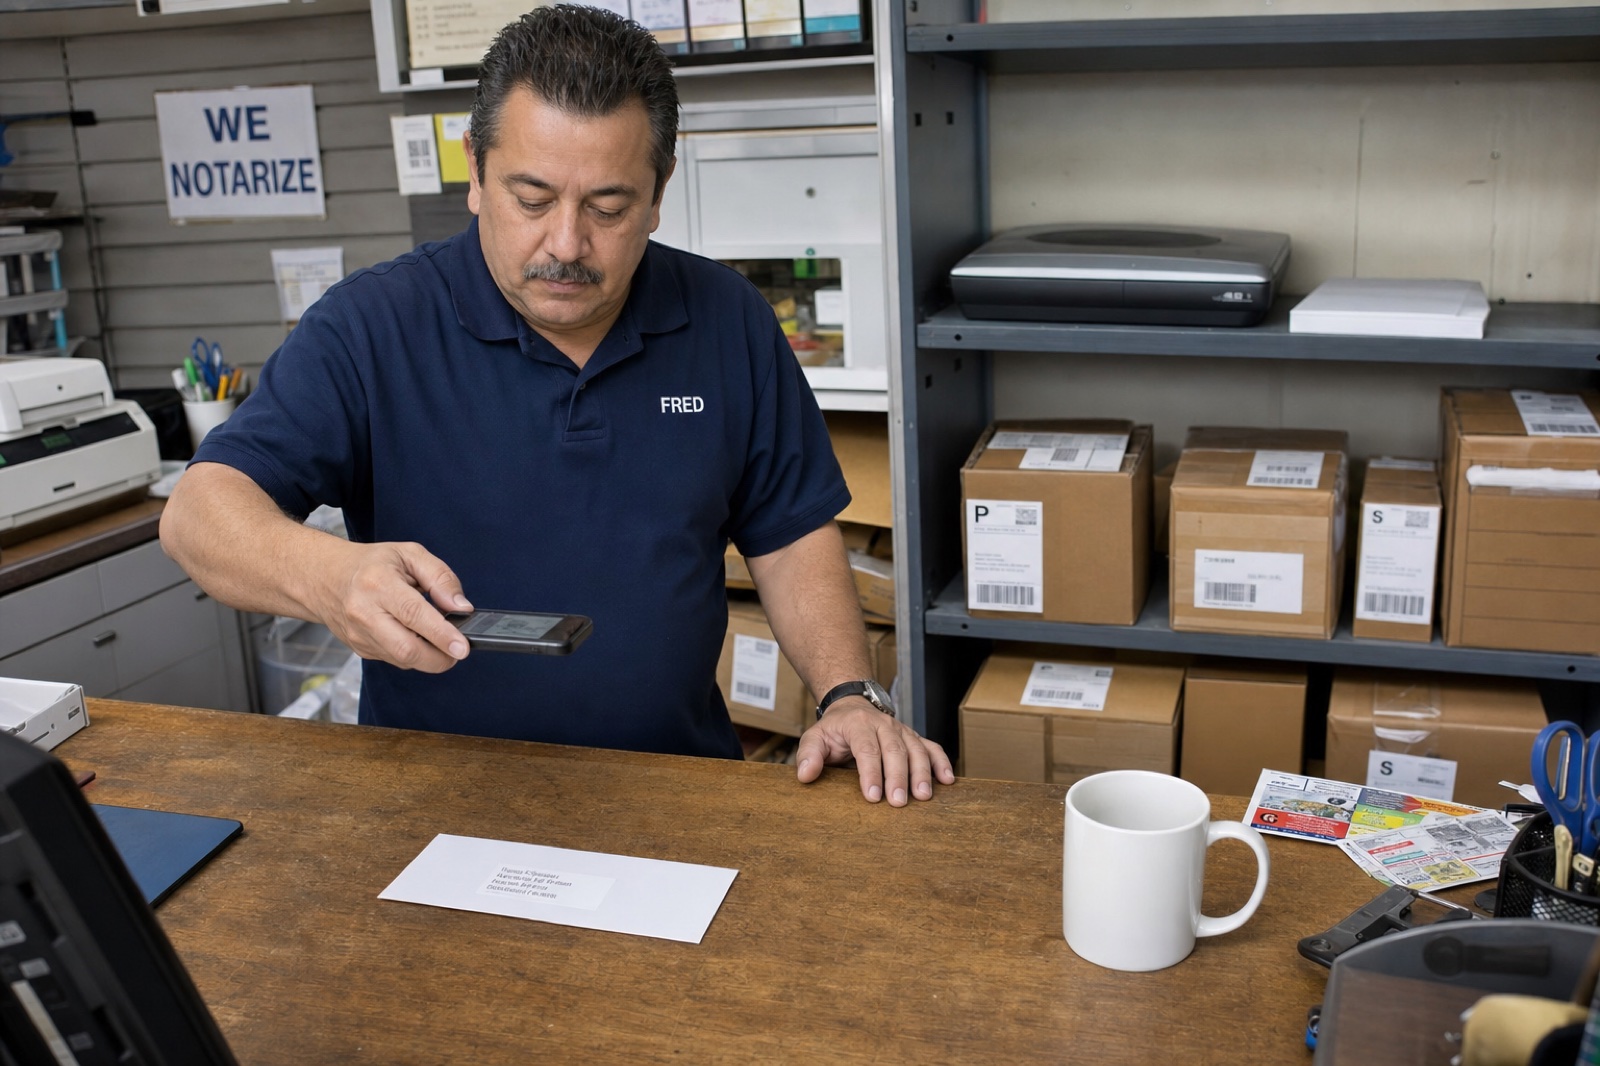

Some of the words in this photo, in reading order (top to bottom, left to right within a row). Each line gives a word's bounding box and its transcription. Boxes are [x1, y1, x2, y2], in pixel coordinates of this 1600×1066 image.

[203, 105, 271, 143] WE
[170, 158, 317, 198] NOTARIZE
[660, 396, 705, 414] FRED
[975, 505, 989, 523] P
[1372, 510, 1384, 524] S
[1380, 760, 1393, 776] S
